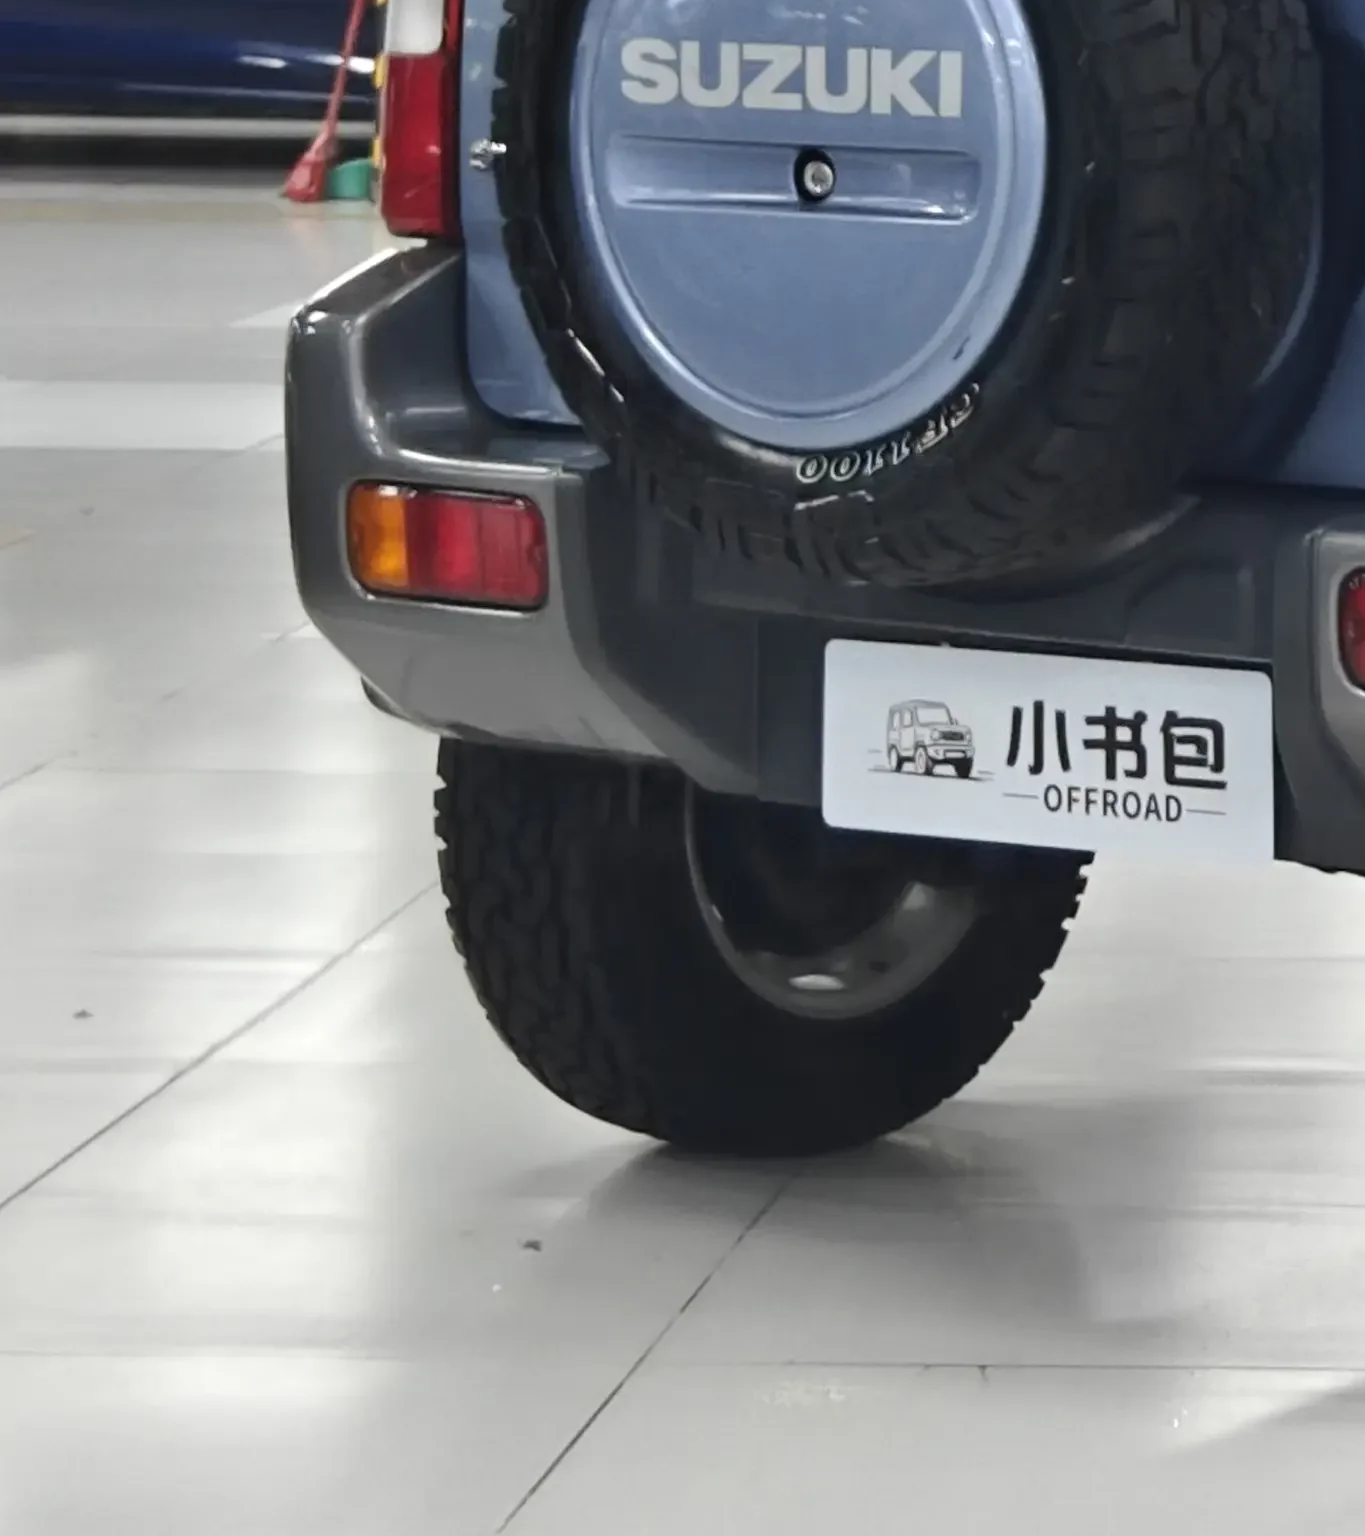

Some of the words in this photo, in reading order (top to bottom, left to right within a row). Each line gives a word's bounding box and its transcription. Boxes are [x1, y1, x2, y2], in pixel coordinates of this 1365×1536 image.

[619, 37, 964, 119] SUZUKI
[796, 382, 981, 484] CF1100
[1006, 700, 1228, 791] 小书包
[1043, 784, 1183, 823] OFFROAD
